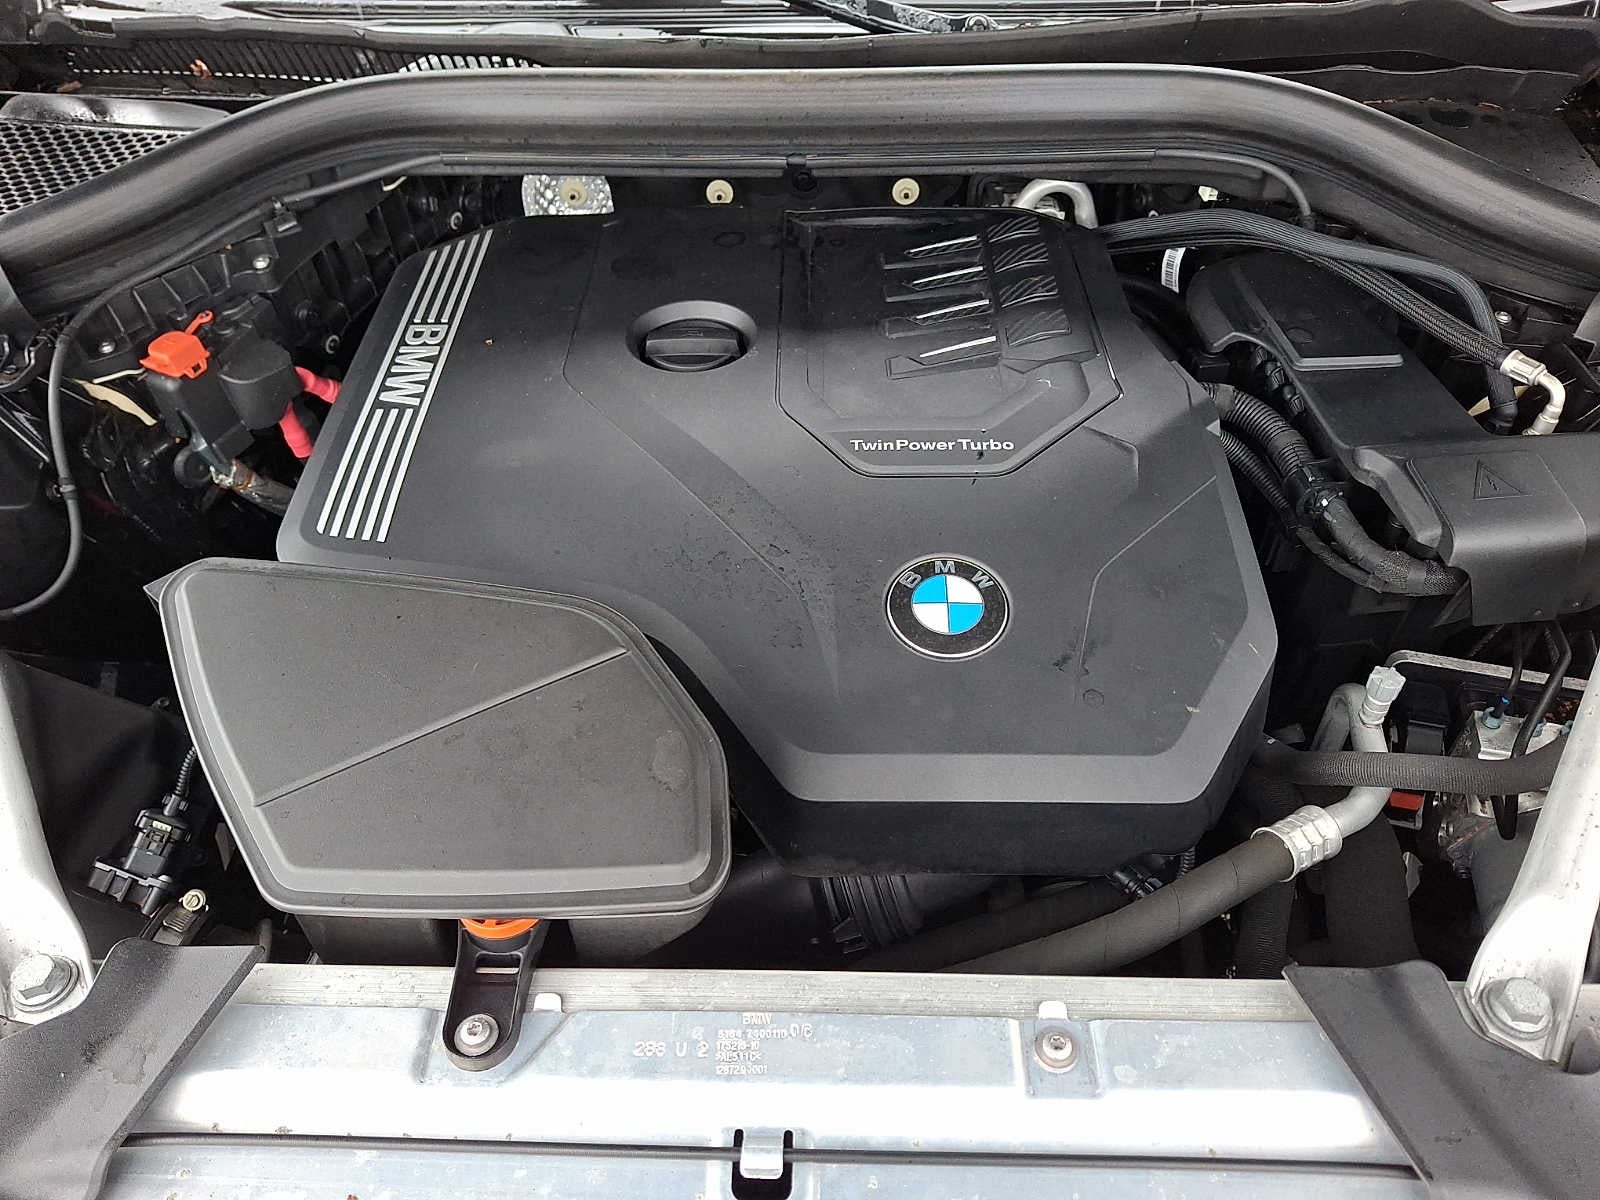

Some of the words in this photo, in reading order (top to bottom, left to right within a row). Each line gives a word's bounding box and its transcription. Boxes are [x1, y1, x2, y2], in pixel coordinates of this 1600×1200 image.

[378, 324, 449, 406] BMW
[957, 438, 1015, 451] Turbo
[898, 559, 995, 589] BMW
[742, 1012, 773, 1024] BMW
[675, 1040, 689, 1057] U
